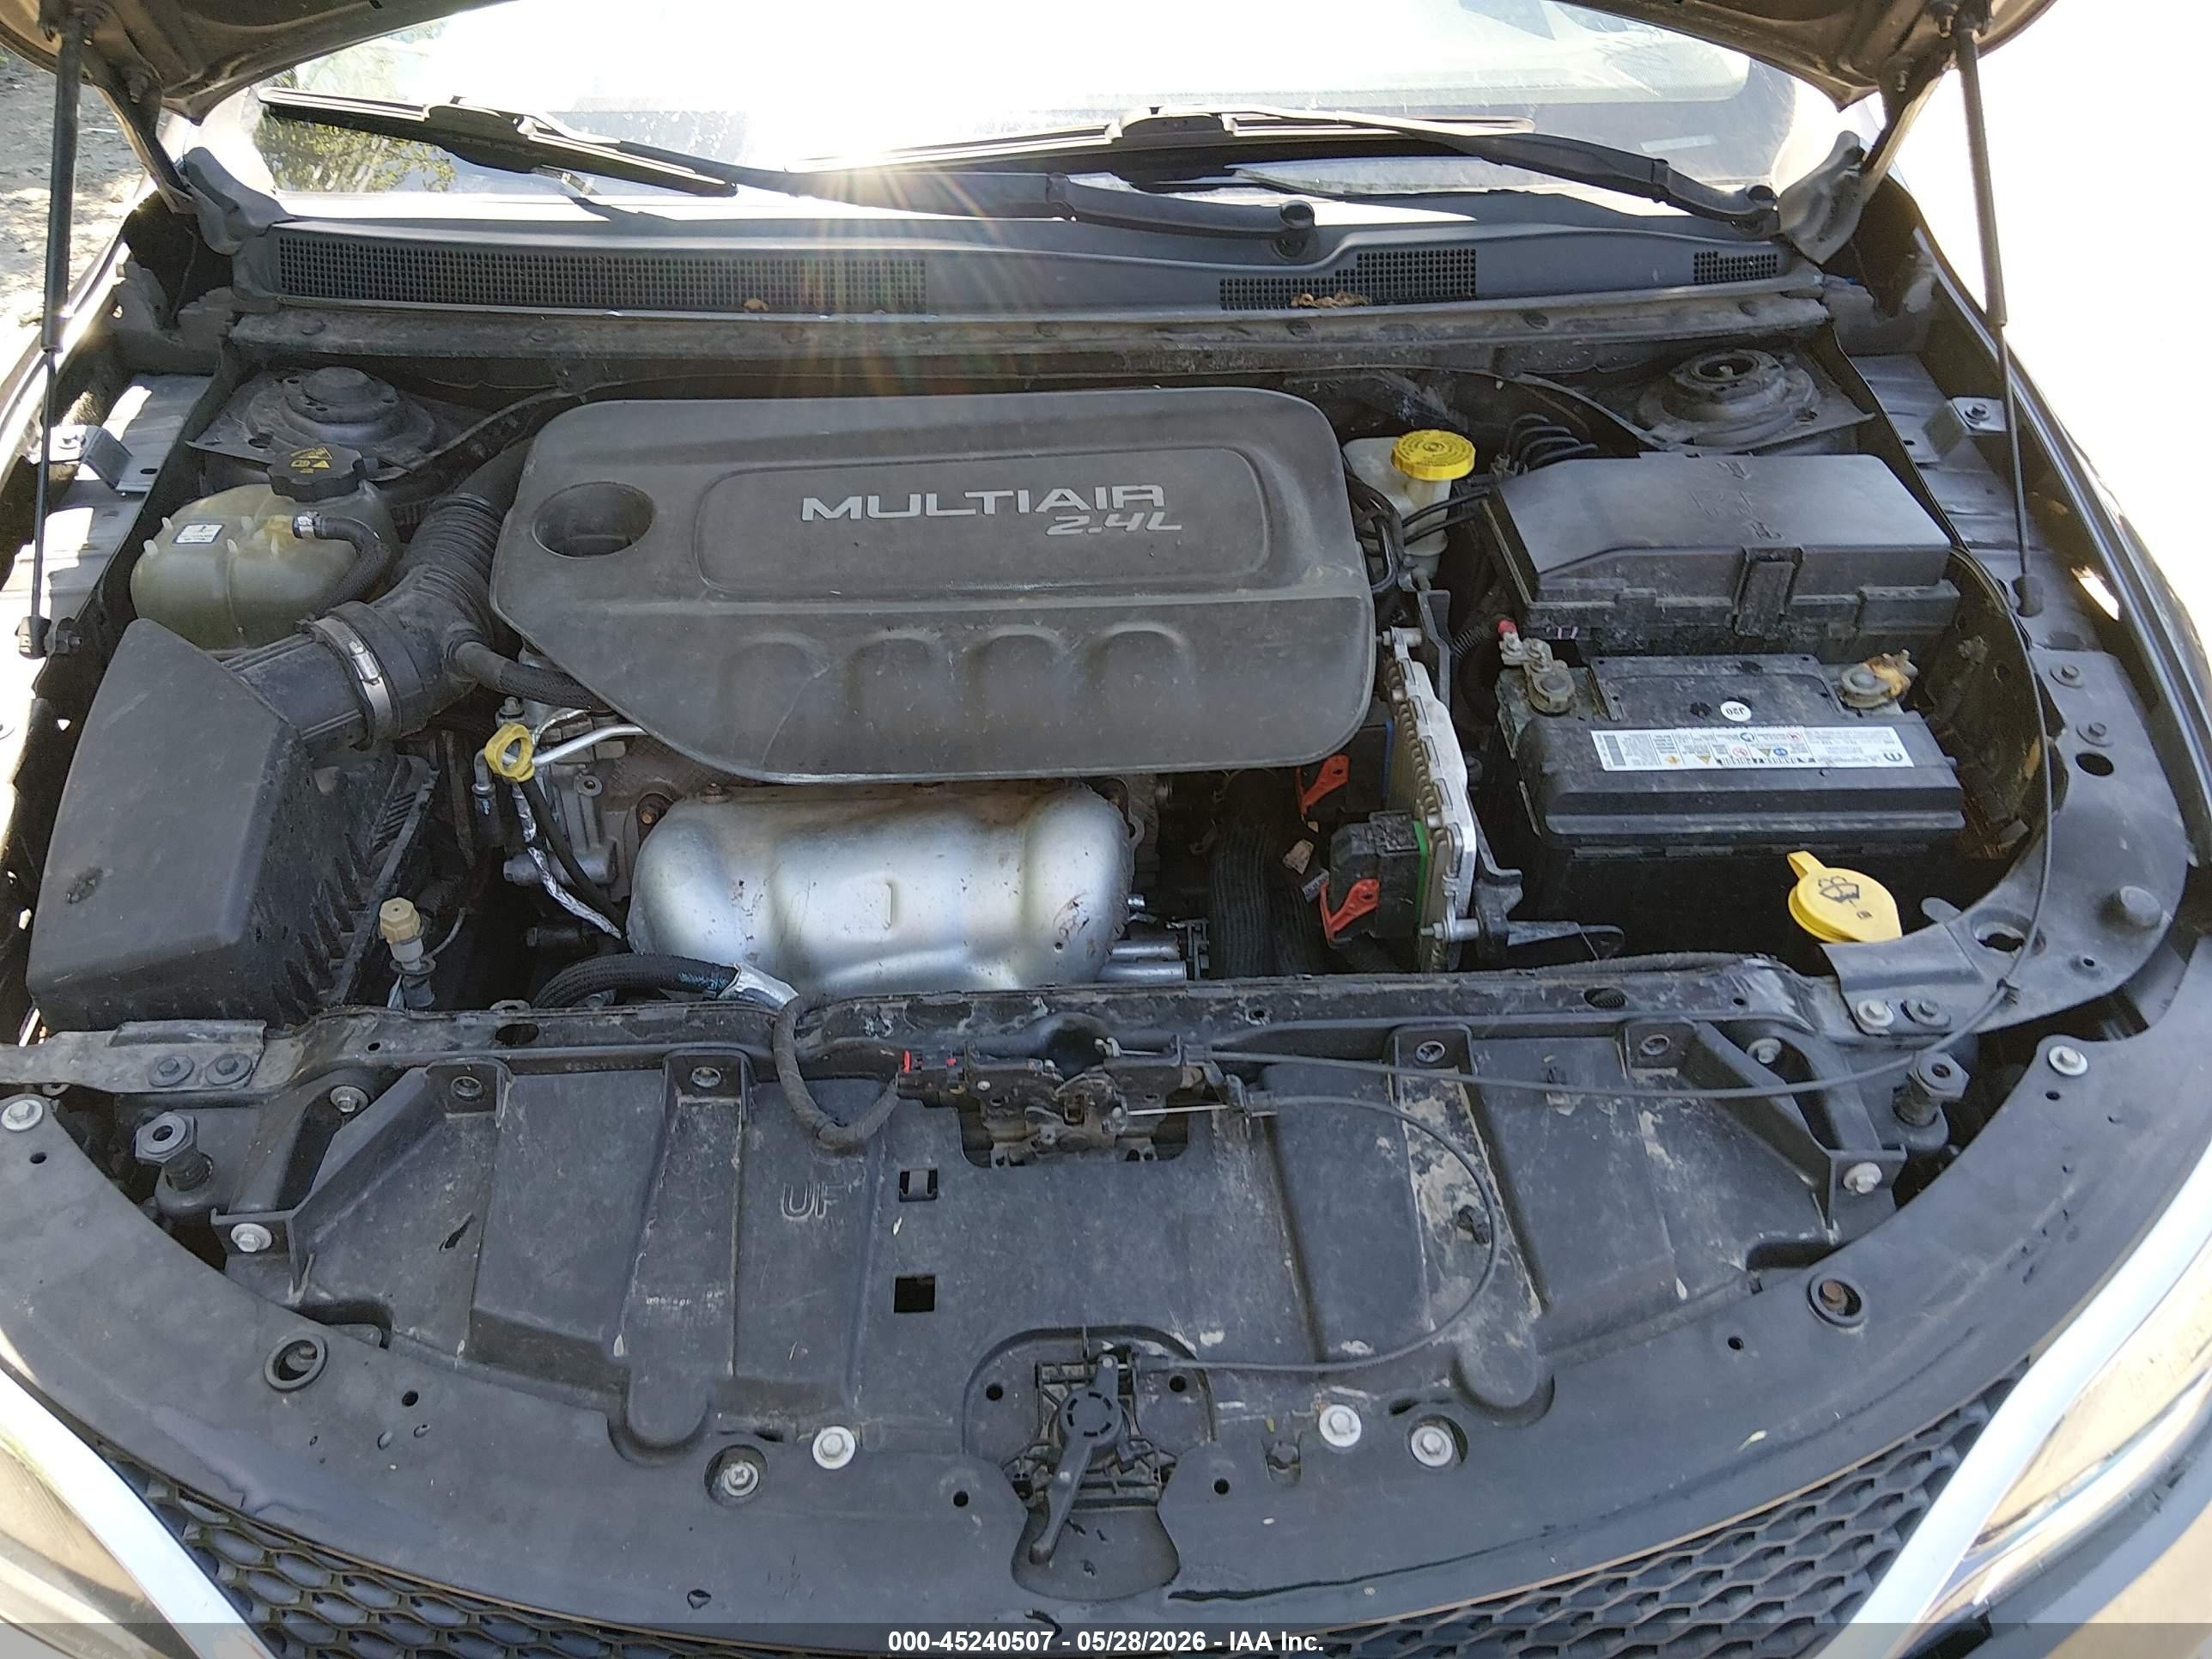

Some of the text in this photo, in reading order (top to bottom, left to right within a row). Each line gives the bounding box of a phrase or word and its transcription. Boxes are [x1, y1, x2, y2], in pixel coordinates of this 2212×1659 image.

[801, 484, 1165, 520] MULTIAIR
[1046, 512, 1182, 536] 2.4L
[1725, 707, 1745, 715] J20
